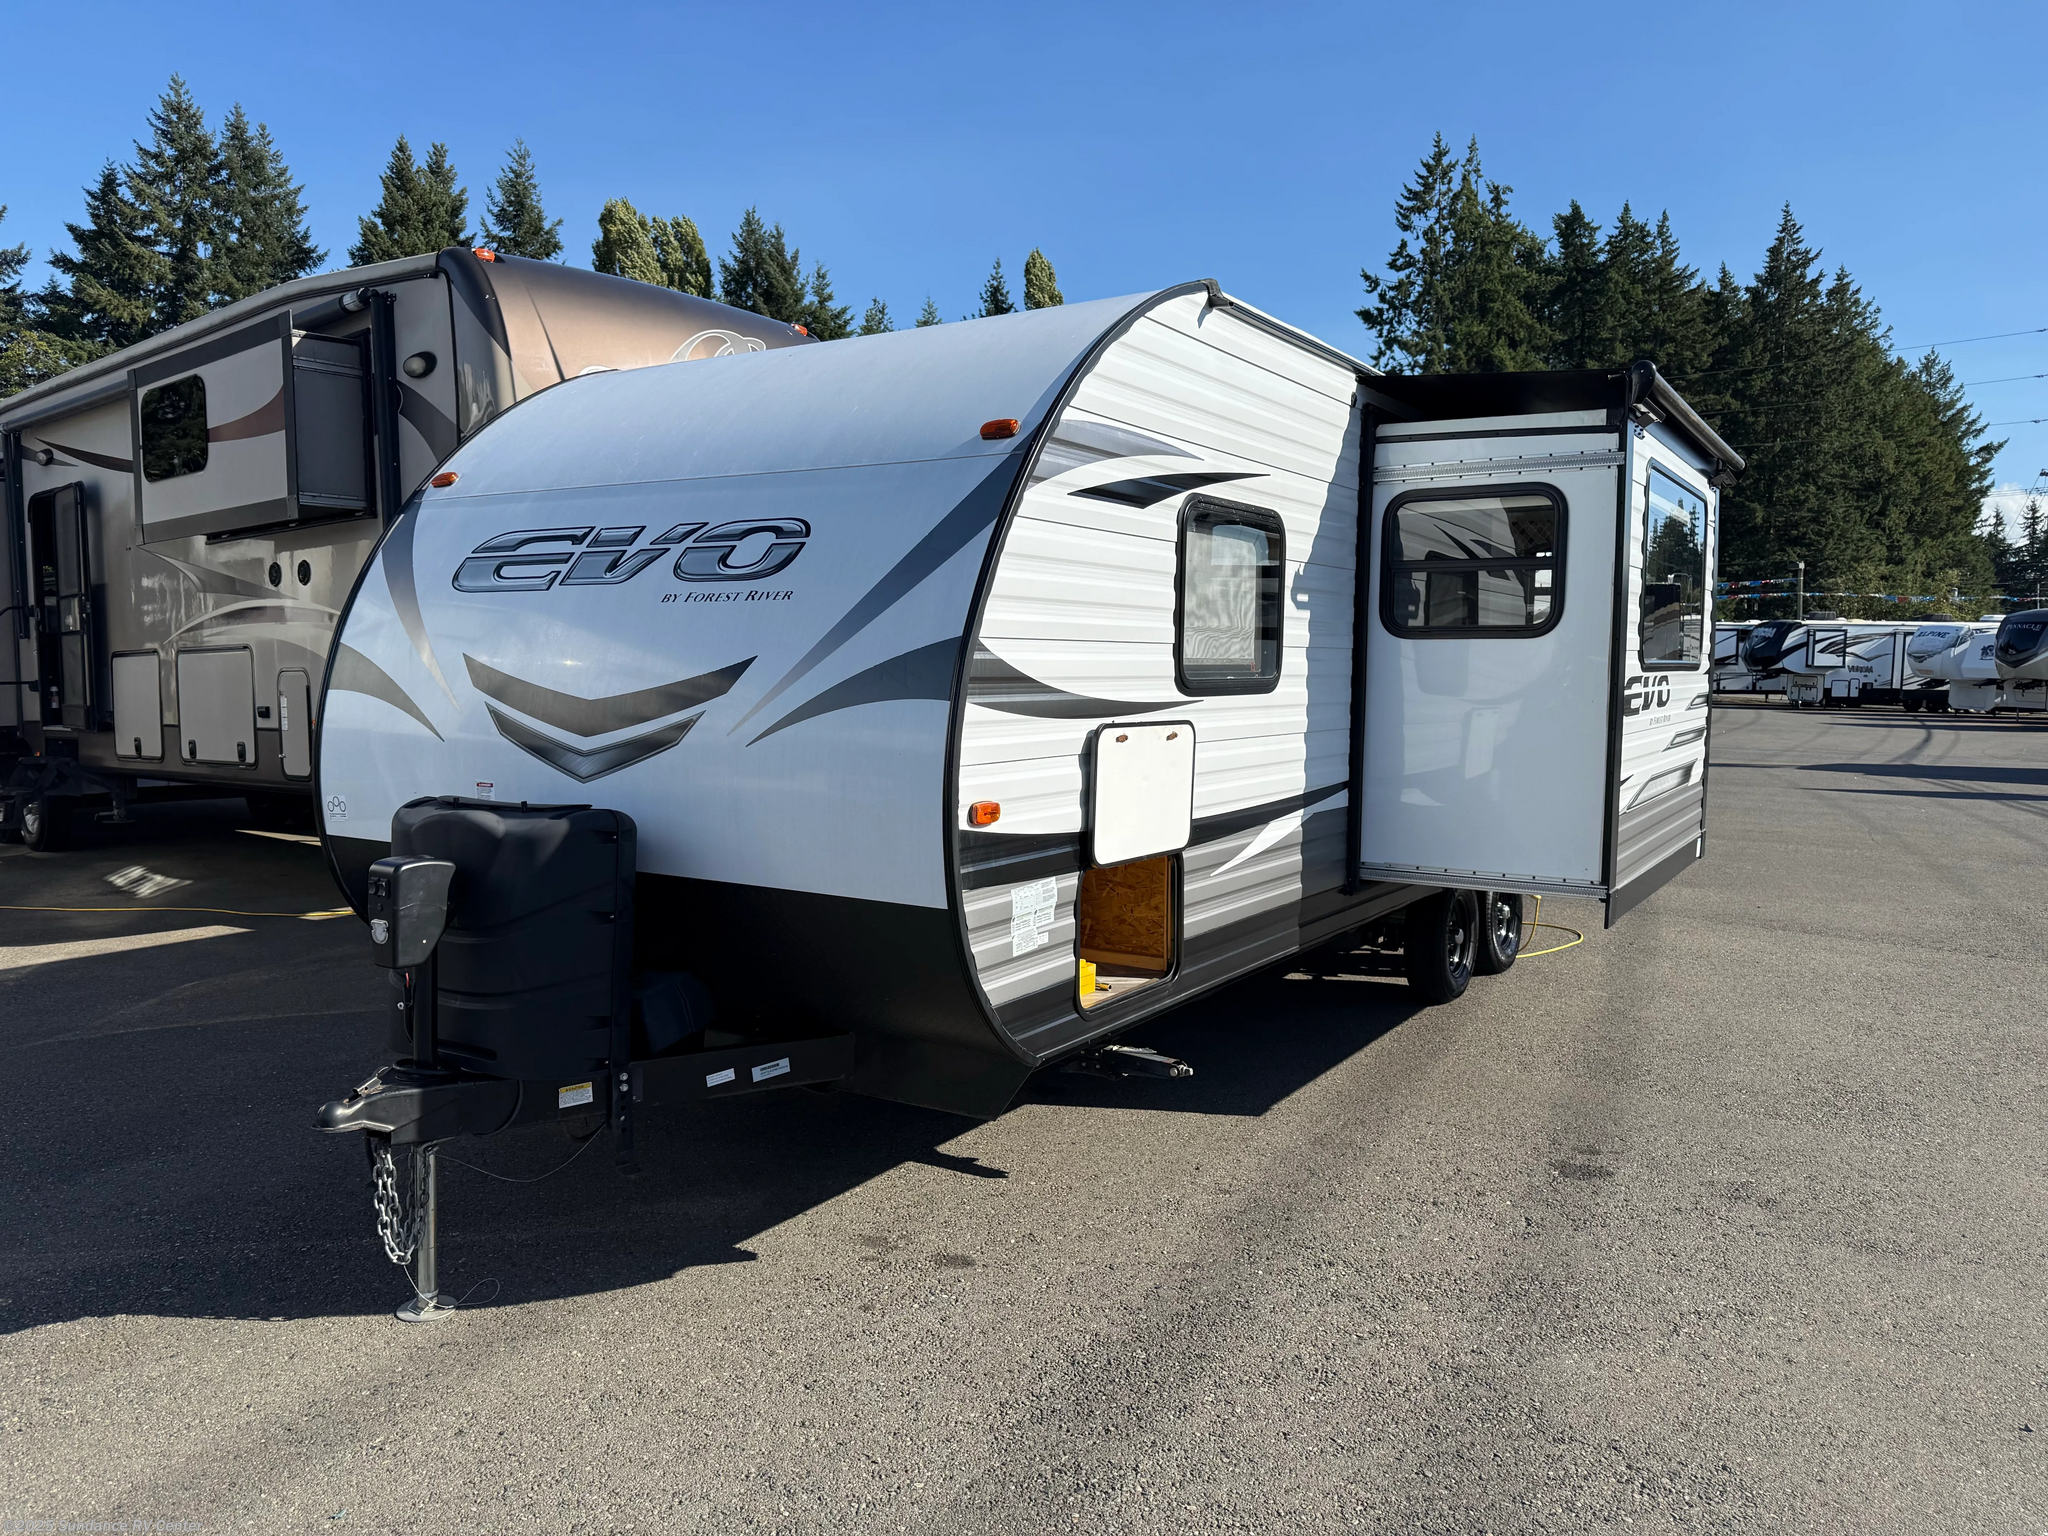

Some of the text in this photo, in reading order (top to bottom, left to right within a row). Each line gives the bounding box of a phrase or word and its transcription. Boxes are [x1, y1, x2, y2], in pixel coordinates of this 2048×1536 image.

[452, 517, 811, 592] EVO
[661, 590, 794, 603] BY FOREST RIVER
[1916, 630, 1950, 639] ALPINE
[1624, 675, 1671, 717] EVO
